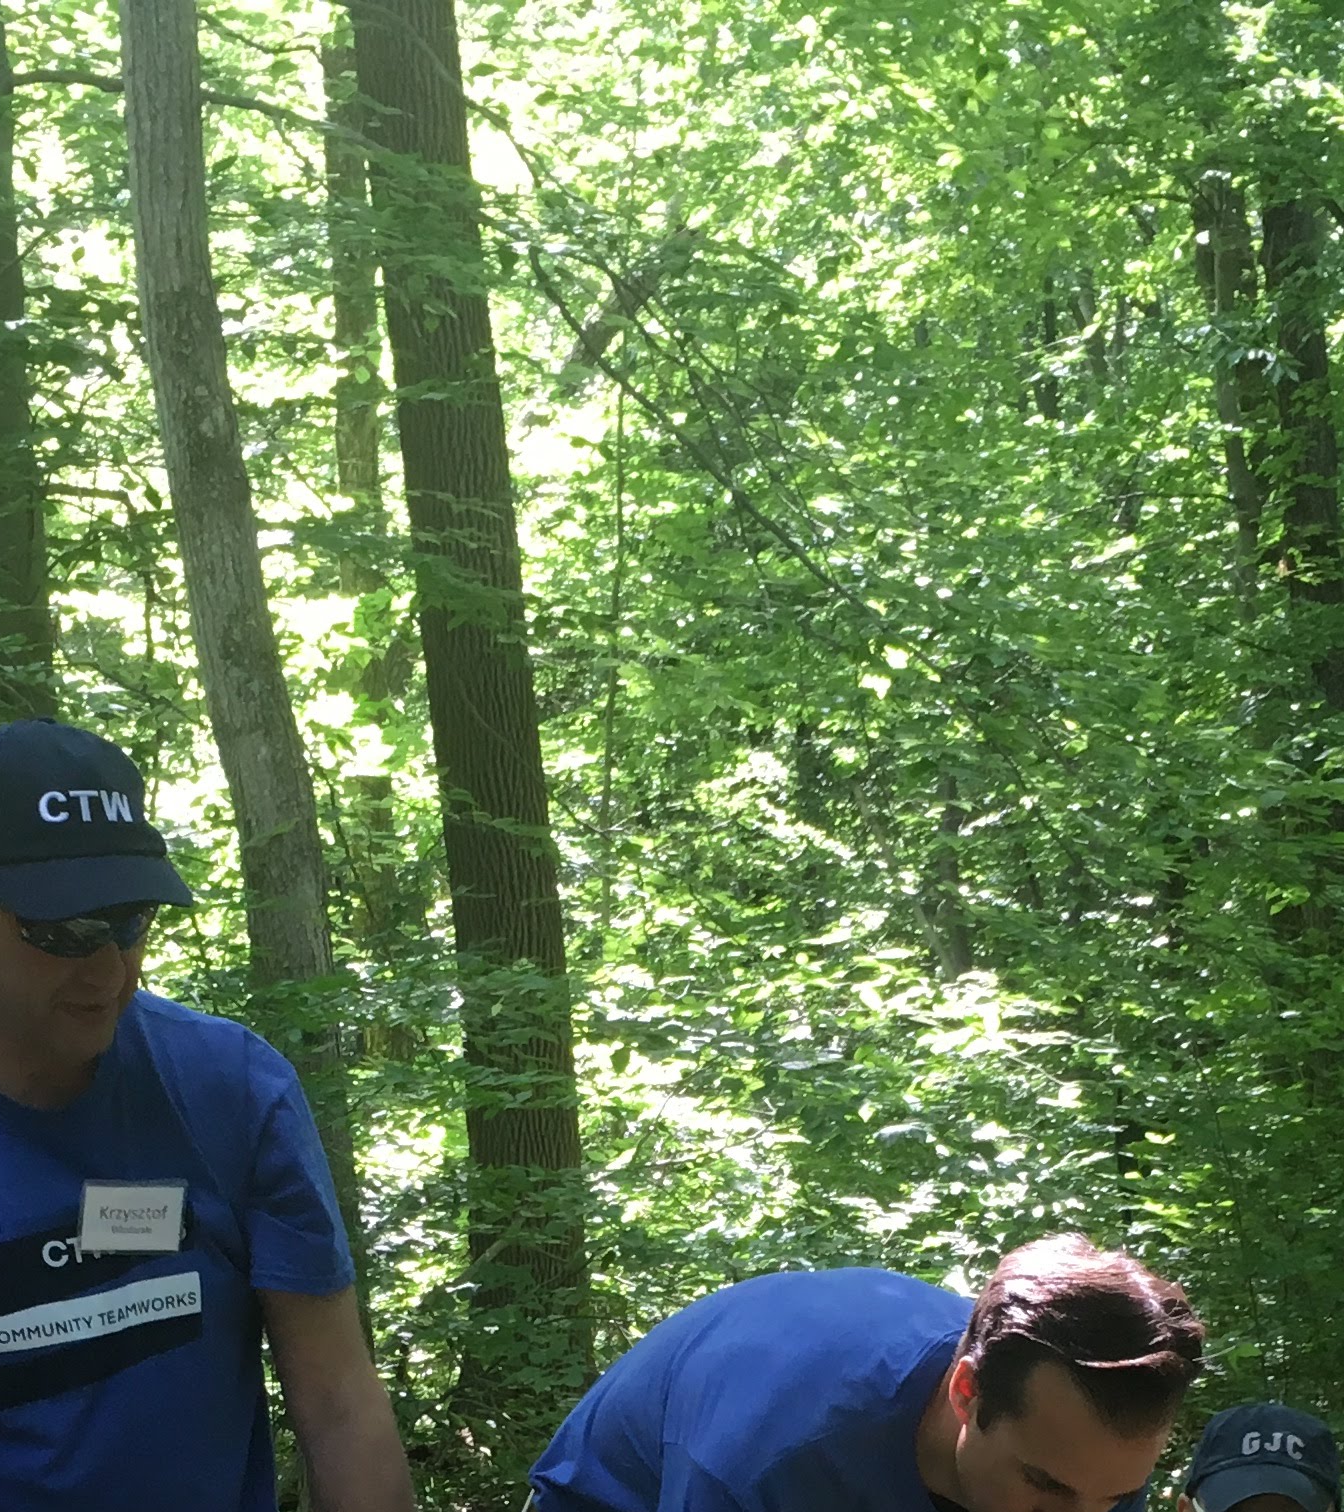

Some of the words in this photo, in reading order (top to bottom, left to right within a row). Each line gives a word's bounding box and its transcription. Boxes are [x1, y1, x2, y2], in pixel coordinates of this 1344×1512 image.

[38, 790, 133, 823] CTW
[100, 1205, 169, 1223] Krzysztof
[97, 1291, 198, 1327] TEAMWORKS
[1241, 1431, 1305, 1460] GJC
